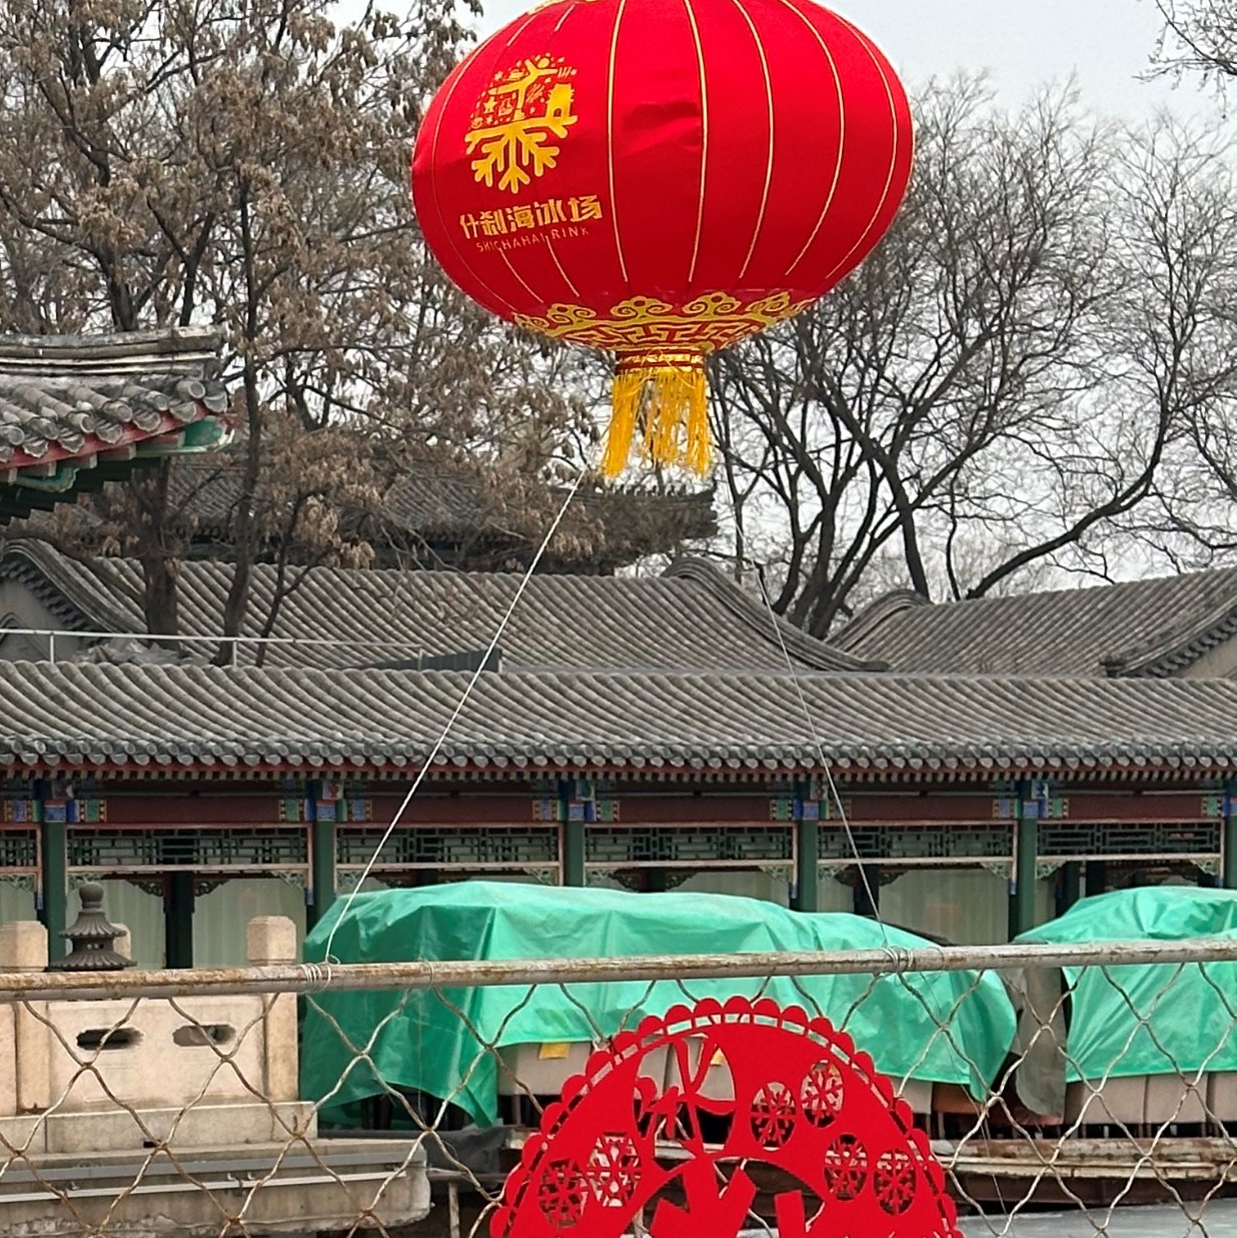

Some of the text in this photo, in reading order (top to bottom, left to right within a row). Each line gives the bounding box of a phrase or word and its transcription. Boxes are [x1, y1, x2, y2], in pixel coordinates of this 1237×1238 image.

[460, 195, 603, 239] 什刹海冰场
[476, 226, 590, 252] SHICHAHAI RINK
